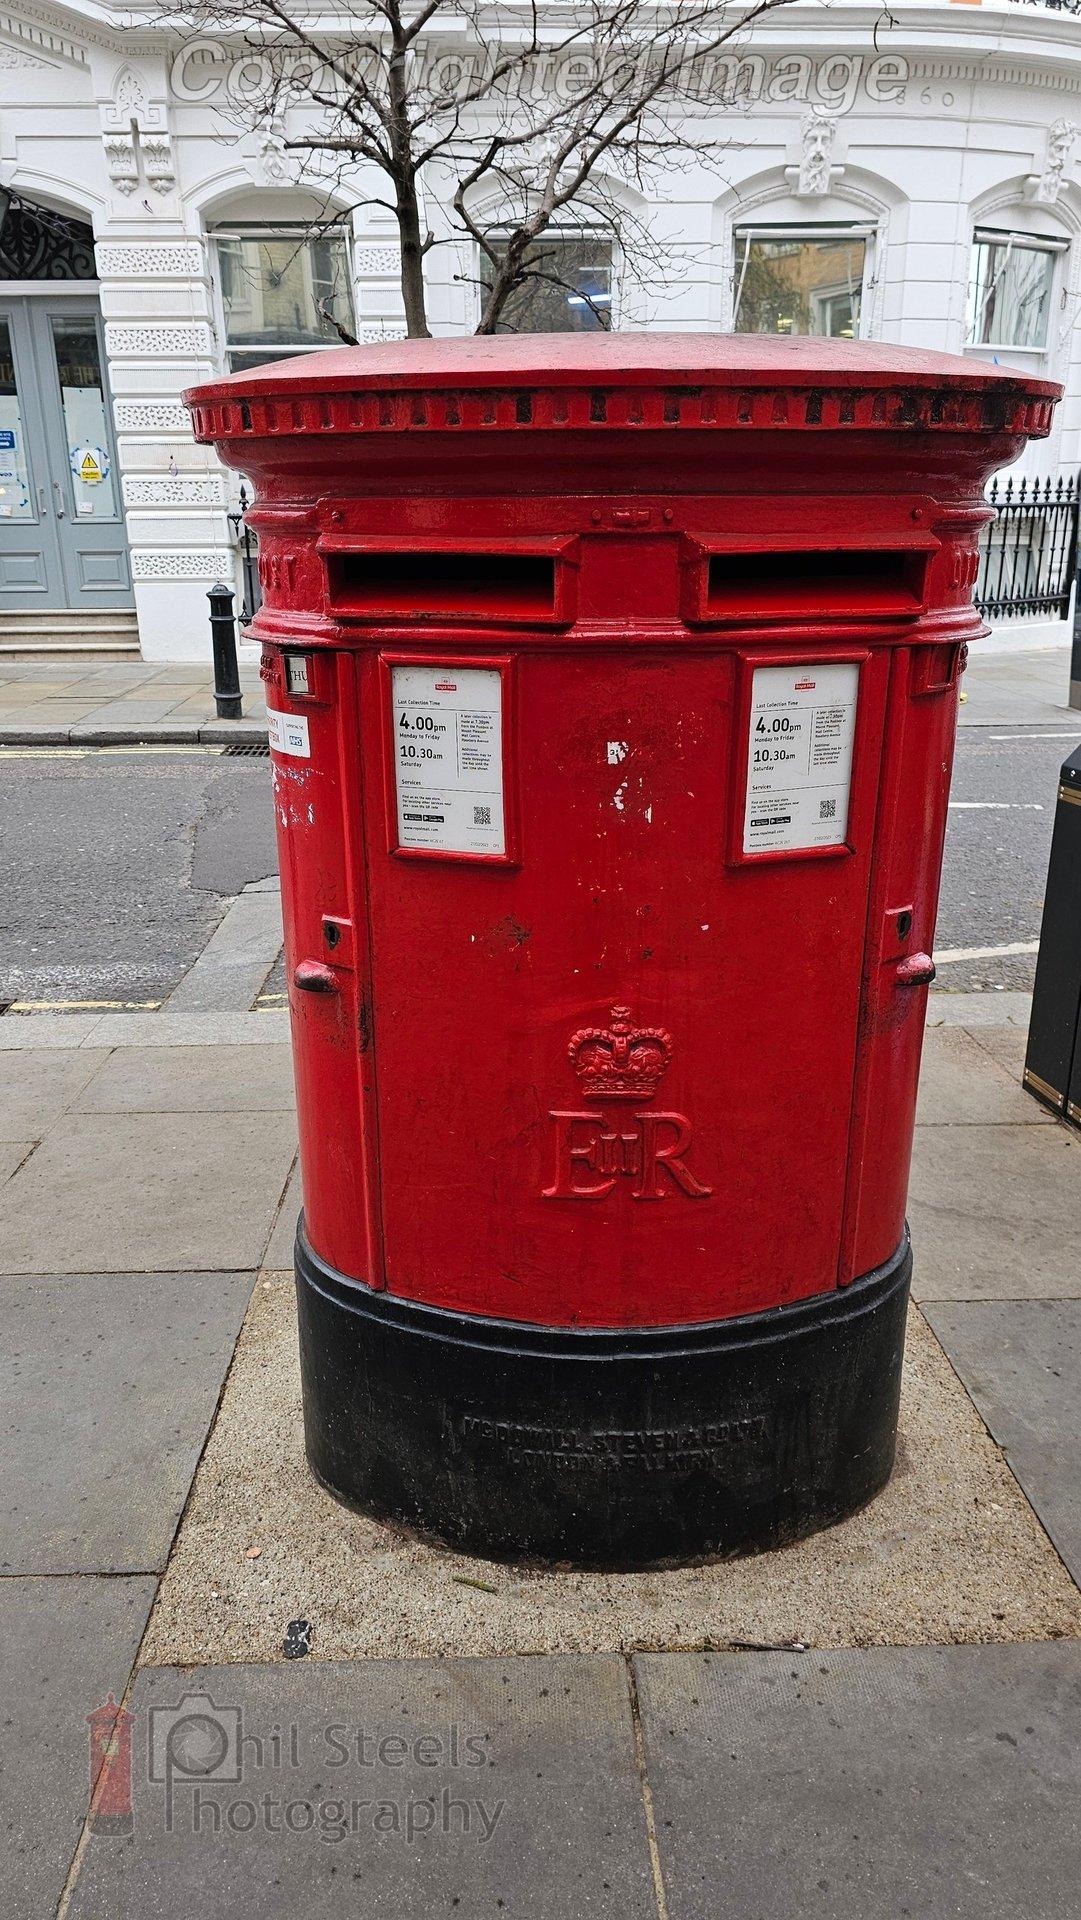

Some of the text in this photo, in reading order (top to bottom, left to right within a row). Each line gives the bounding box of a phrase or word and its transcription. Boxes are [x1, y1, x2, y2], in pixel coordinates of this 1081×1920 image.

[289, 670, 308, 681] THU
[399, 712, 446, 732] 4.00pm
[756, 716, 801, 734] 4.00pm
[289, 735, 302, 746] NHS
[400, 745, 443, 759] 10.30am
[754, 749, 795, 763] 10.30am
[593, 1430, 678, 1449] STEVEN
